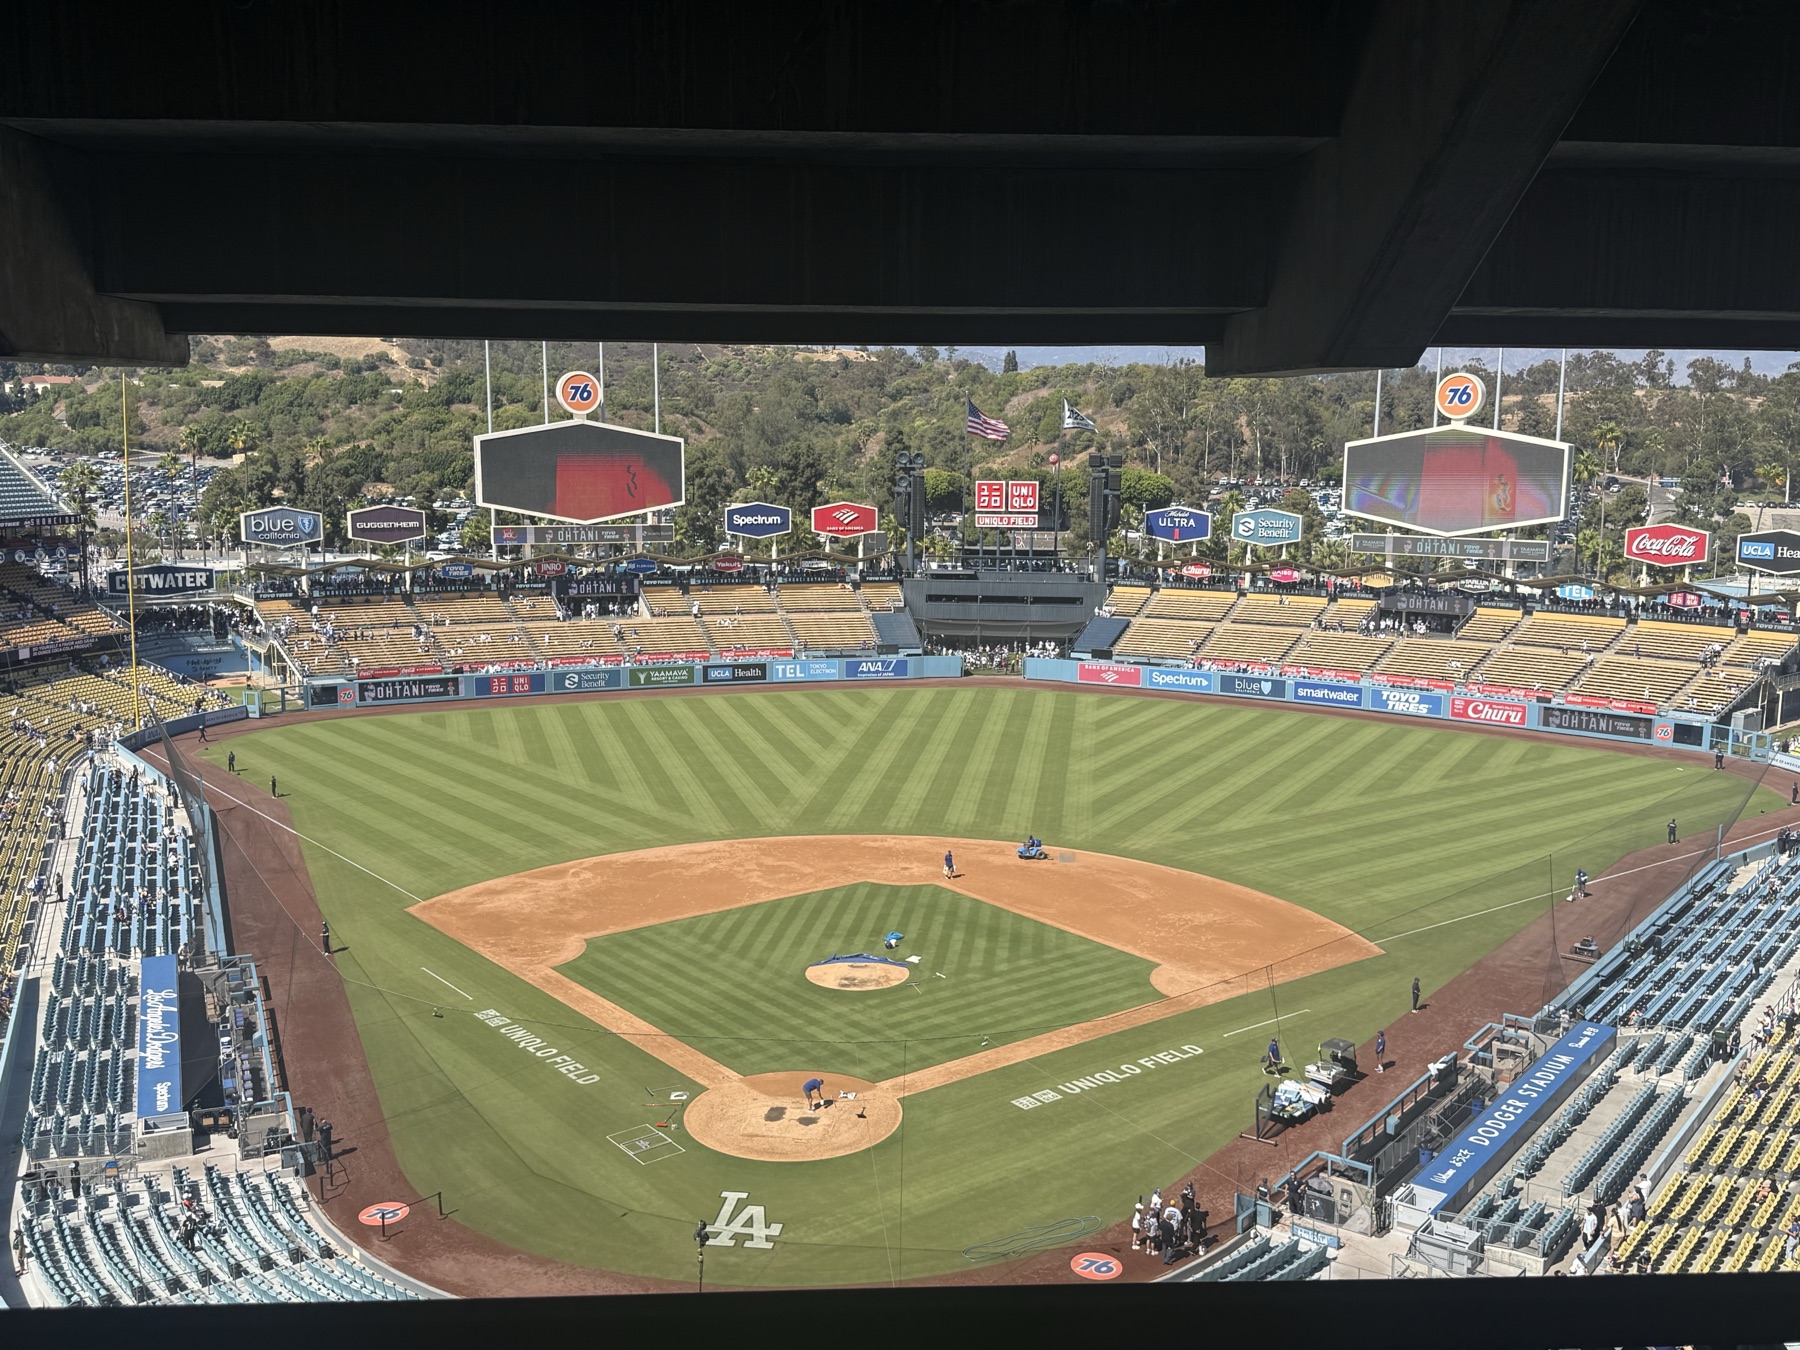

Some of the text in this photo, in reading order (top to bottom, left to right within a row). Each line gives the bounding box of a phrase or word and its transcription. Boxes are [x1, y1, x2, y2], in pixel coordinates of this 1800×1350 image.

[568, 382, 592, 402] 76
[1445, 385, 1473, 407] 76
[1012, 486, 1032, 496] UNI
[1012, 496, 1034, 508] QLO
[31, 518, 62, 526] SHOHEI
[251, 516, 294, 532] blue
[733, 515, 780, 526] Spectrum
[979, 518, 1009, 526] UNIQLO
[1159, 518, 1196, 528] ULTRA
[1258, 518, 1294, 529] Security
[258, 532, 300, 540] california
[558, 531, 598, 540] OHTANI
[1258, 528, 1290, 538] Benefit
[1417, 541, 1460, 554] OHTANI
[1632, 534, 1700, 557] Coca-Cola
[1743, 545, 1772, 556] UCLA
[1183, 566, 1210, 574] Churu
[580, 582, 616, 594] OHTANI
[1565, 586, 1589, 598] TEL
[1410, 599, 1448, 610] OHTANI
[735, 668, 762, 677] Health
[776, 664, 804, 678] TEL
[858, 662, 882, 672] ANA
[581, 673, 610, 681] Security
[1152, 670, 1202, 684] Spectrum
[1235, 679, 1260, 690] blue
[340, 692, 353, 700] 76
[377, 684, 424, 698] OHTANI
[1298, 687, 1359, 701] smartwater
[1382, 690, 1420, 702] TOYO
[1387, 701, 1429, 714] TIRES
[1468, 702, 1522, 723] Churu
[1562, 714, 1612, 732] OHTANI
[1657, 728, 1670, 737] 76
[139, 1032, 178, 1069] Dodgers
[500, 1024, 600, 1084] UNIQLO FIELD
[1057, 1044, 1203, 1094] UNIQLO FIELD
[1450, 1149, 1475, 1168] ようこそ
[1468, 1100, 1529, 1147] DODGER
[1518, 1054, 1575, 1098] STADIUM
[366, 1207, 401, 1221] 76
[704, 1190, 784, 1249] LA
[1079, 1257, 1114, 1274] 76
